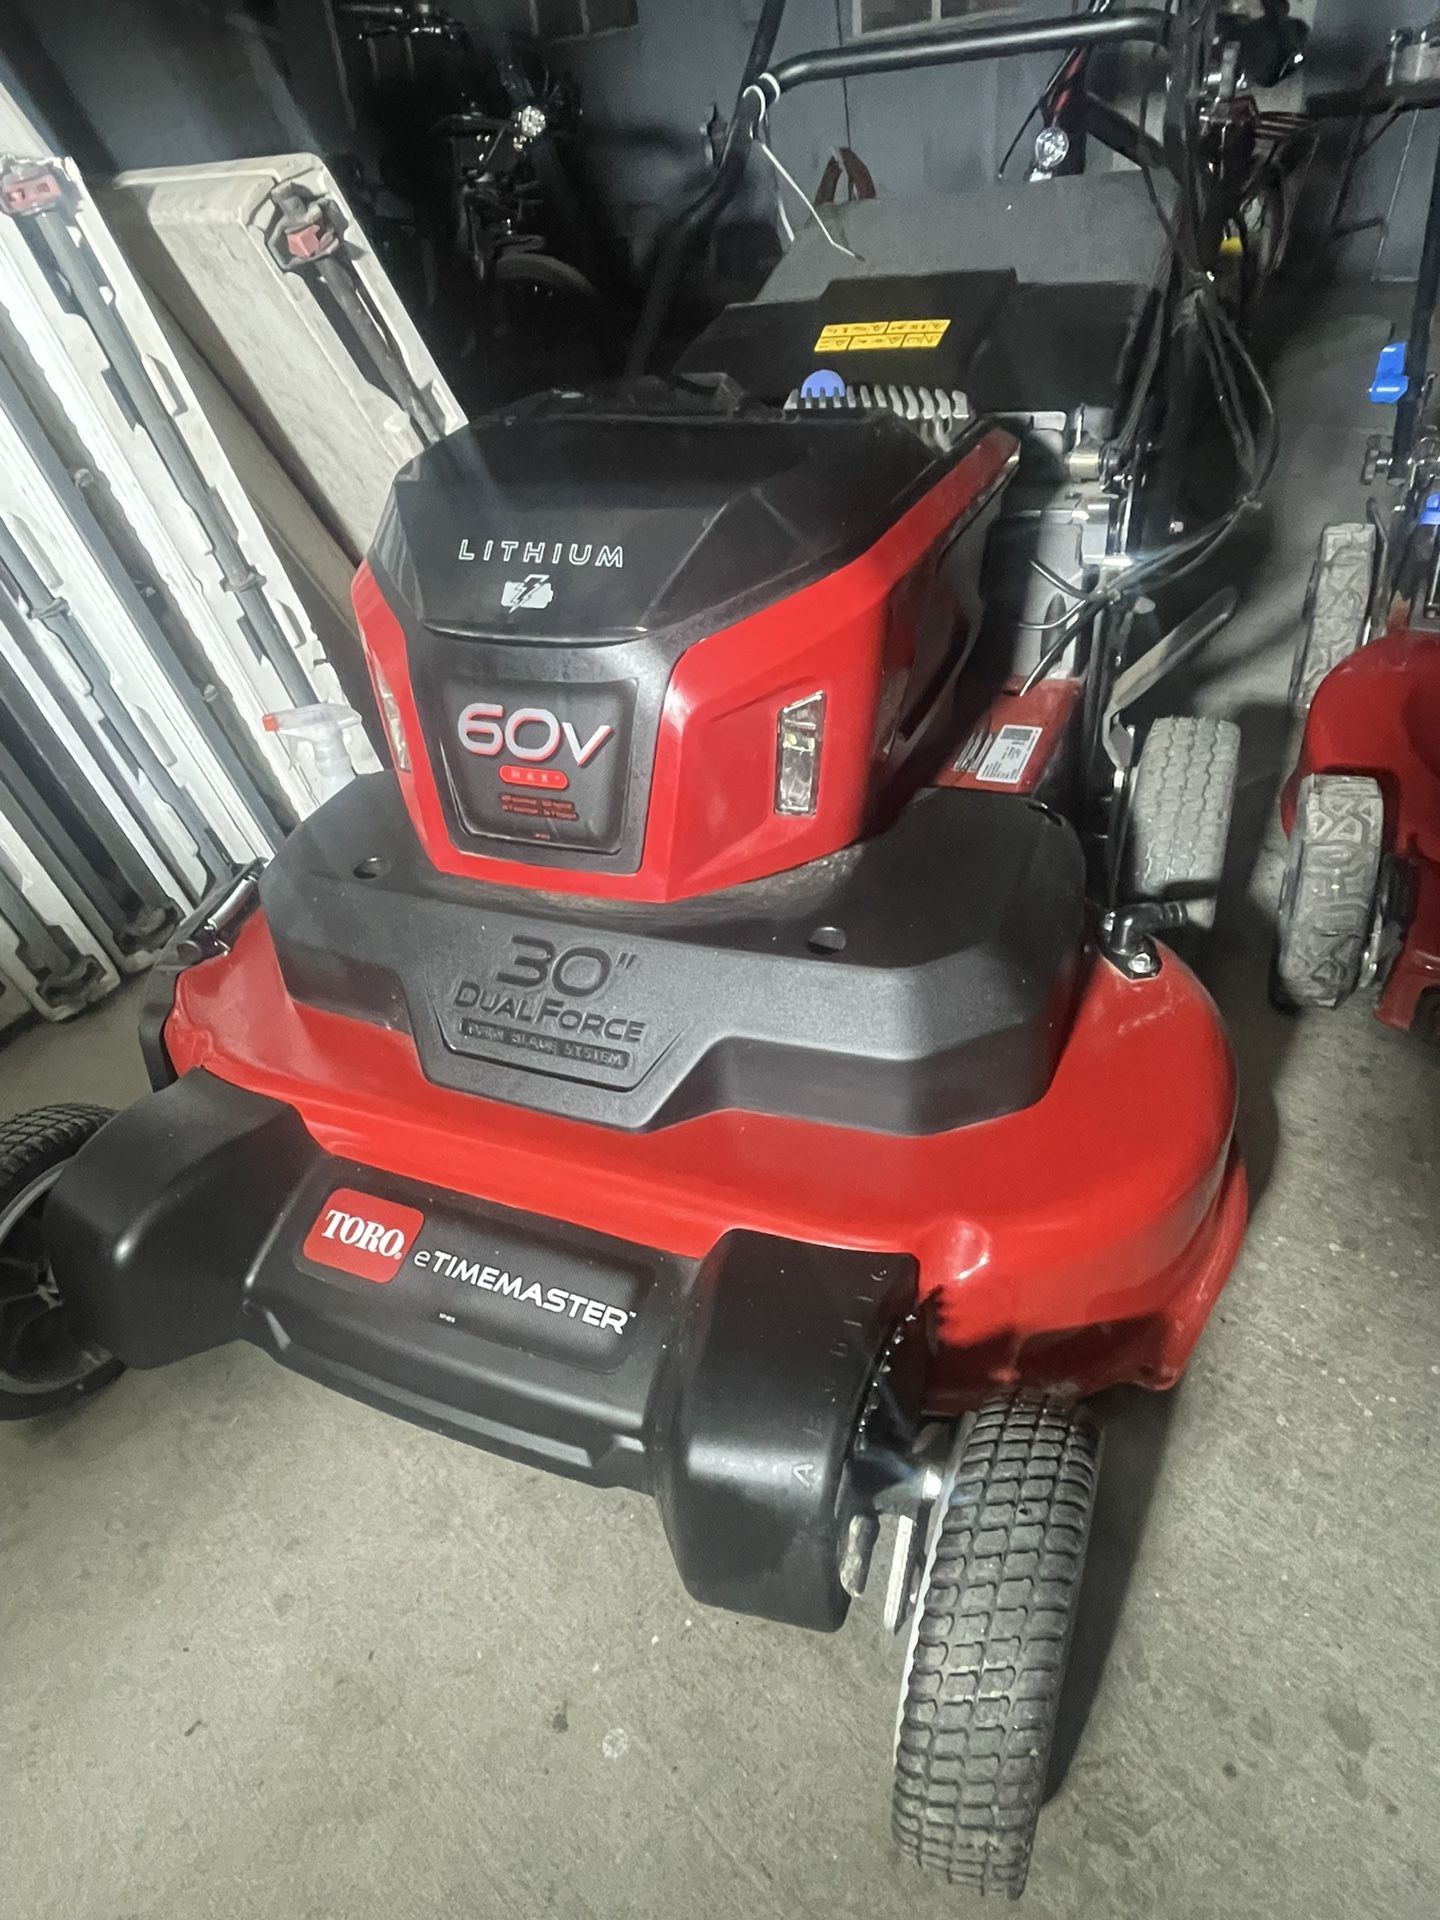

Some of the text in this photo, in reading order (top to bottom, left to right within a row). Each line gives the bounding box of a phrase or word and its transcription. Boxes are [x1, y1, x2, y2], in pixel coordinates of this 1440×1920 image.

[458, 539, 623, 568] LITHIUM
[458, 702, 613, 766] 60V
[497, 934, 638, 997] 30"
[565, 1042, 622, 1067] SYSTEM
